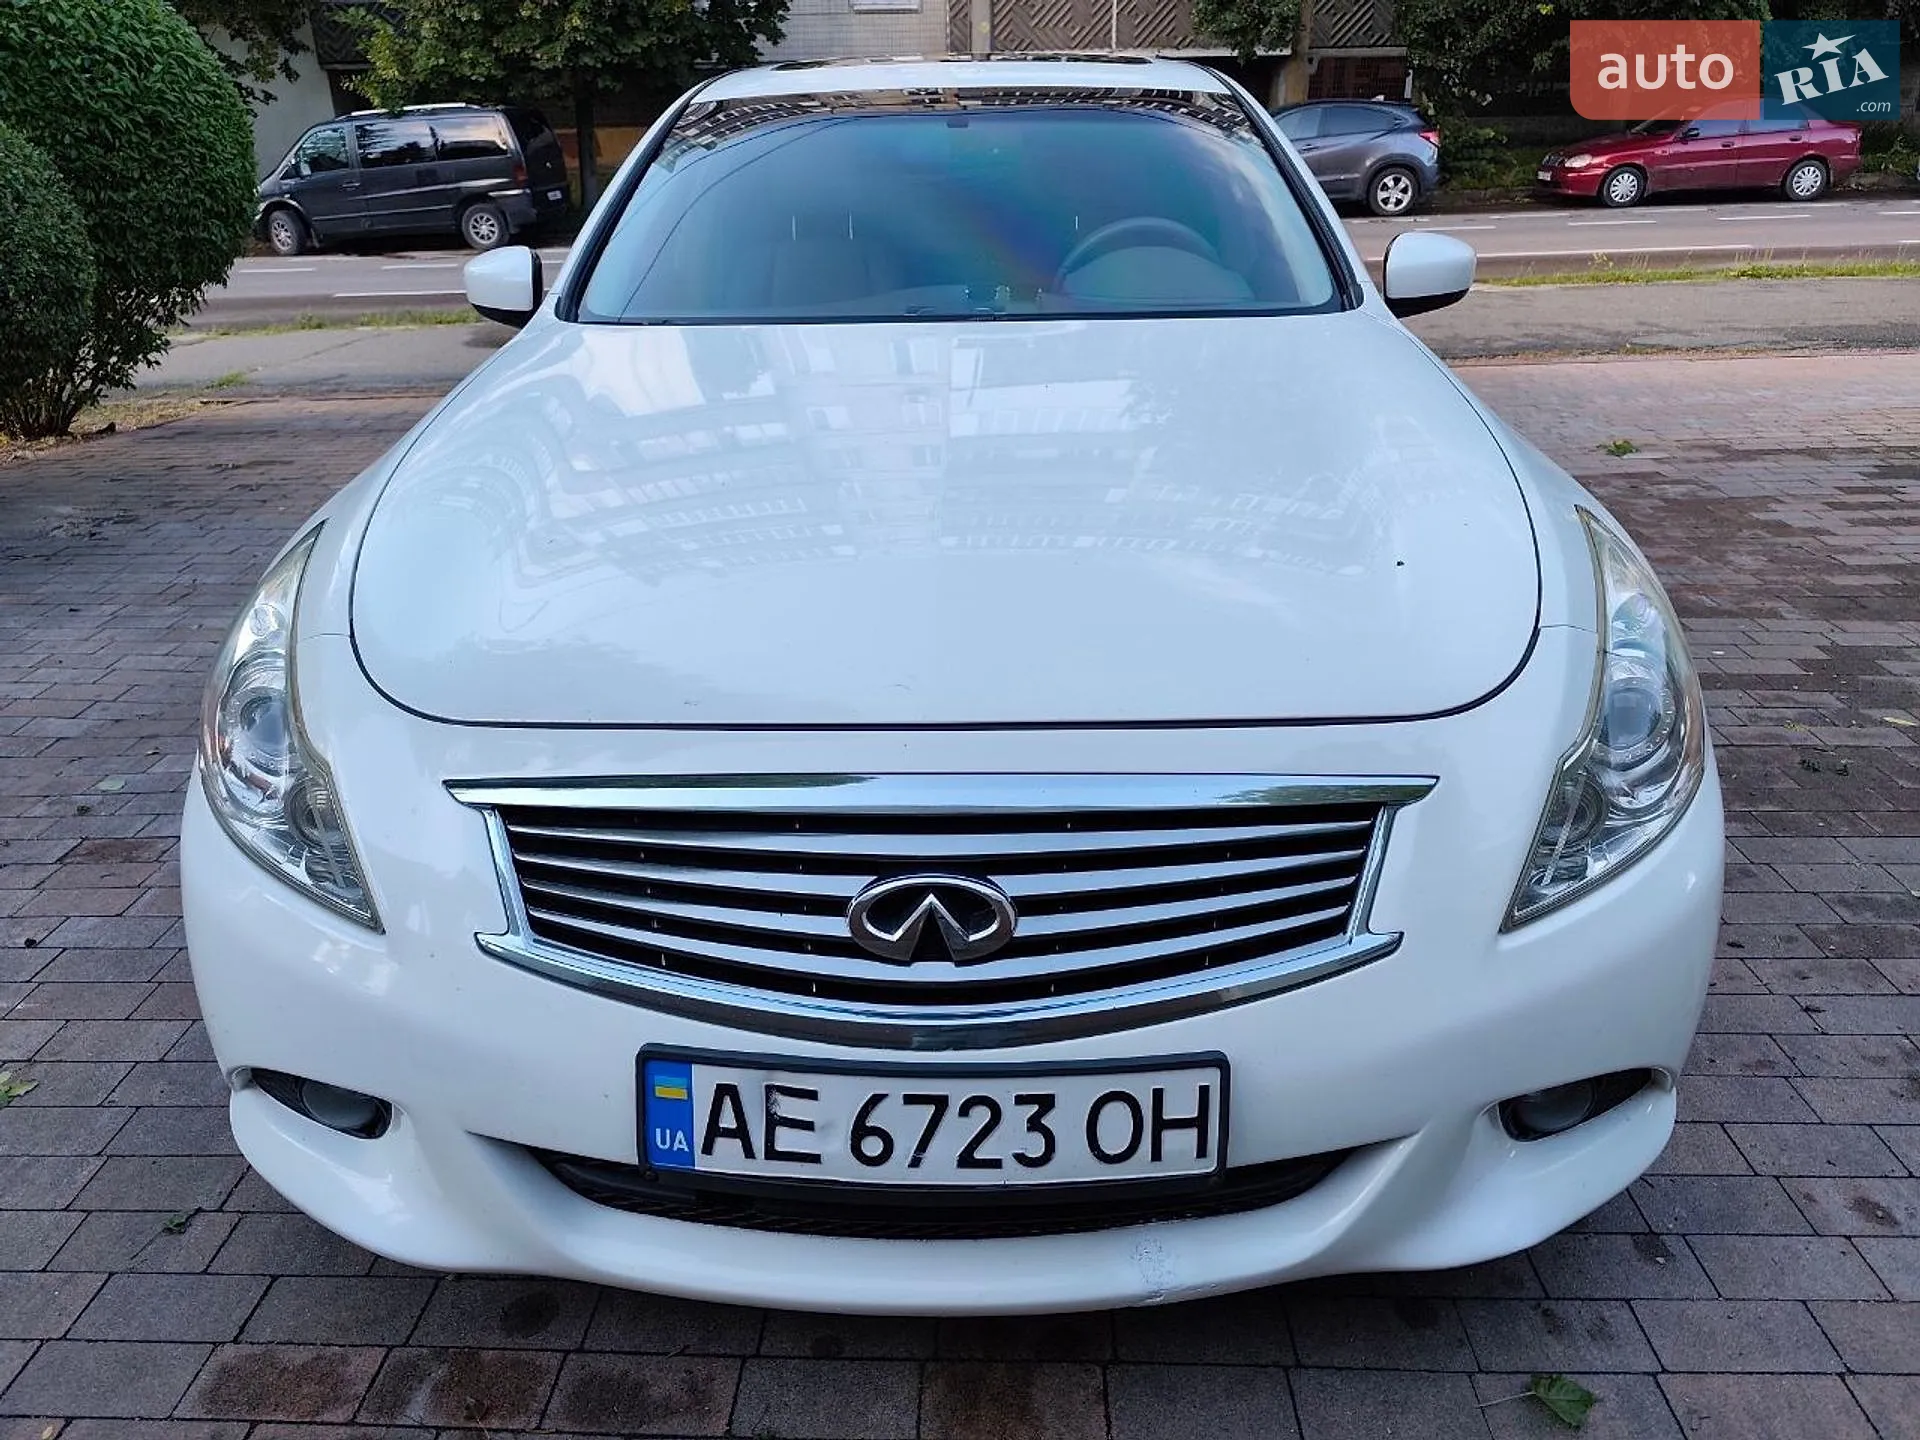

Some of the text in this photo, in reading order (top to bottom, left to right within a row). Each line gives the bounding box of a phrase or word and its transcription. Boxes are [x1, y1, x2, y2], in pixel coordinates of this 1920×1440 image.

[655, 1127, 689, 1152] UA
[701, 1083, 1211, 1169] AE 6723 OH
